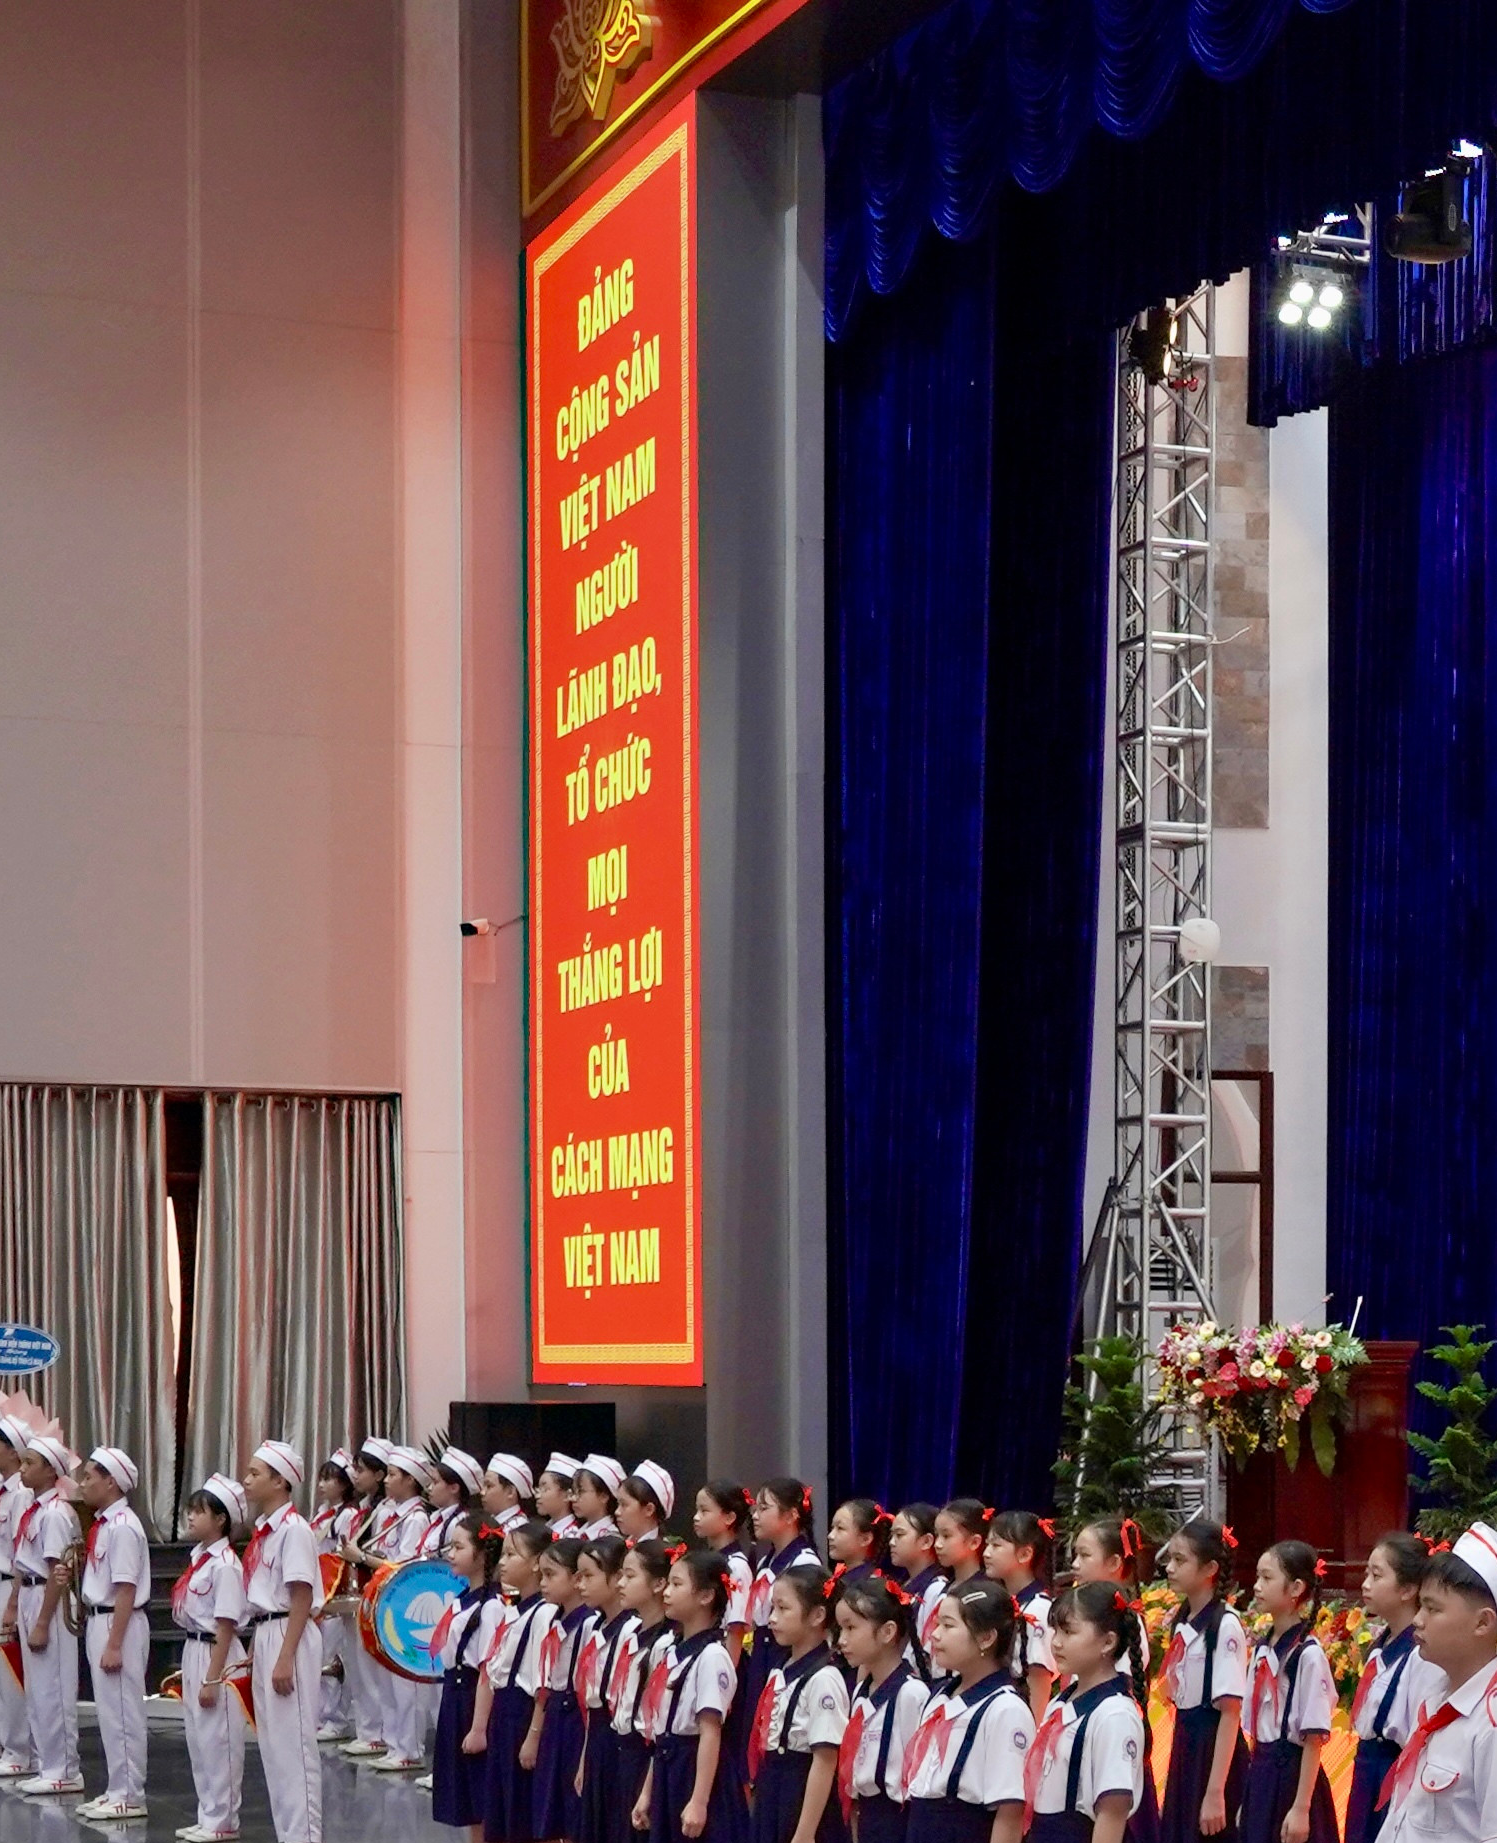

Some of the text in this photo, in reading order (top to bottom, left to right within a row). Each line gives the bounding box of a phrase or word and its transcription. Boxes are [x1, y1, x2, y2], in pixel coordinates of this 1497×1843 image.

[577, 258, 634, 352] ĐẢNG
[556, 330, 660, 463] CỘNG SẢN
[560, 436, 655, 551] VIỆT NAM
[575, 540, 638, 635] NGƯỜI
[556, 636, 662, 739] LÃNH ĐẠO,
[565, 732, 651, 827] TỔ CHỨC
[587, 844, 627, 916] MỌI
[558, 926, 663, 1013] THẮNG LỢI
[588, 1023, 630, 1100] CỦA
[551, 1126, 674, 1201] CÁCH MẠNG
[563, 1223, 660, 1299] VIỆT NAM
